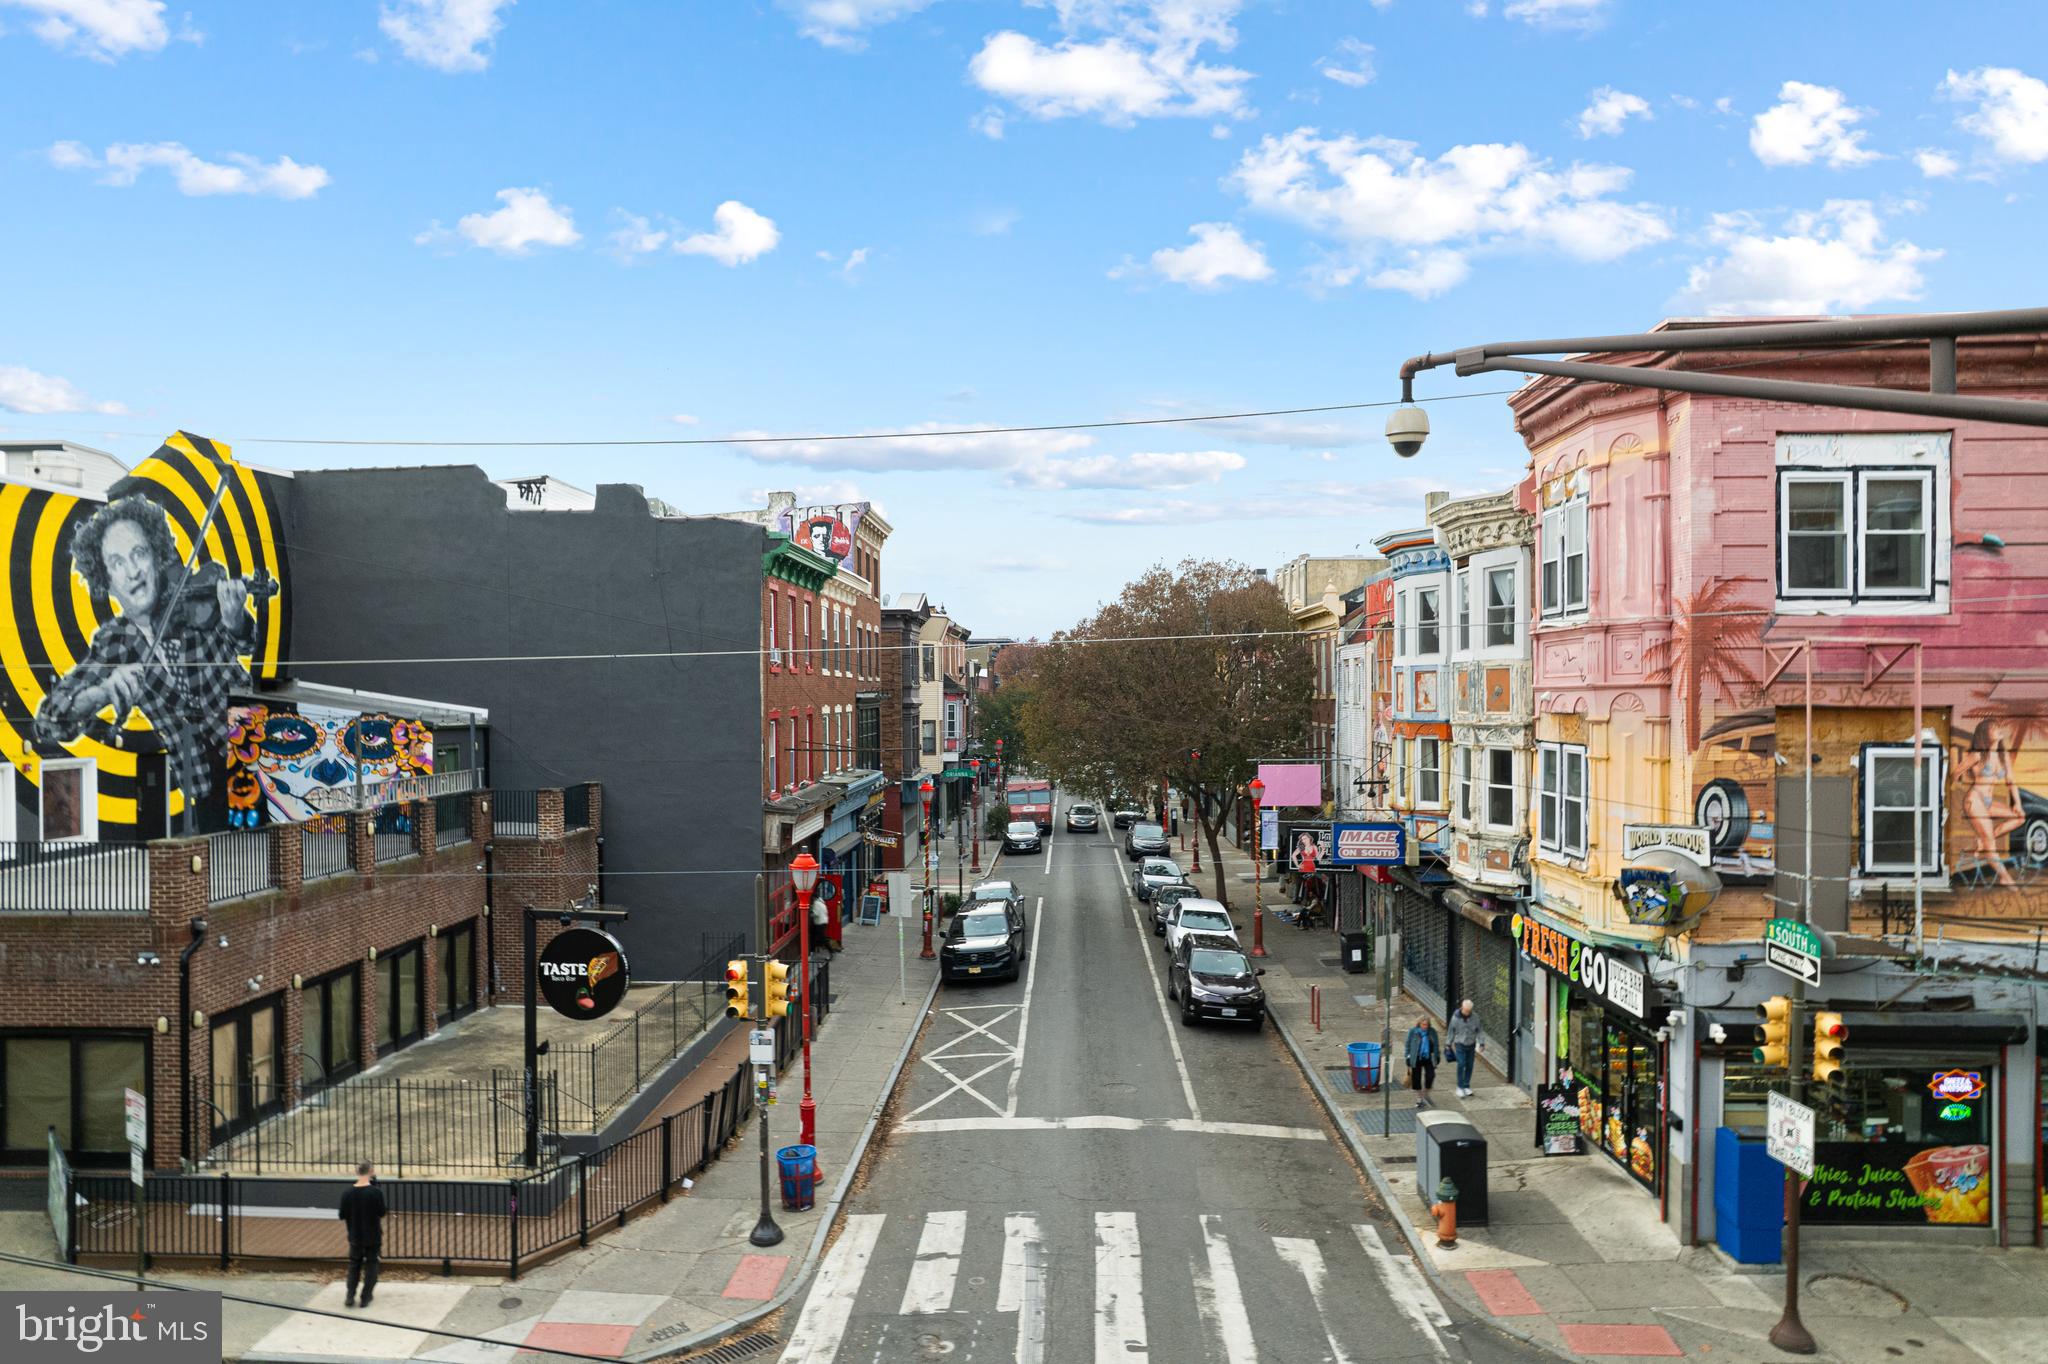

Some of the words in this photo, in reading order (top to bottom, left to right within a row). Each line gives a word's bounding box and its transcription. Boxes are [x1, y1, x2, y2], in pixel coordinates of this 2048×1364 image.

[1340, 831, 1399, 843] IMAGE
[1629, 830, 1661, 851] WORLD
[1665, 830, 1706, 855] FAMOUS
[1343, 849, 1357, 857] ON
[1360, 849, 1396, 857] SOUTH
[1523, 916, 1568, 975] FRESH
[1775, 926, 1808, 952] SOUTH
[540, 962, 588, 976] TASTE
[1773, 949, 1788, 963] ONE
[1789, 956, 1804, 970] WAY
[1611, 962, 1627, 985] JUICE
[1630, 972, 1642, 993] BAR
[1620, 986, 1638, 1010] GRILL
[1809, 1191, 1822, 1207] &
[1827, 1189, 1881, 1210] Protein
[1885, 1188, 1943, 1211] Shakes
